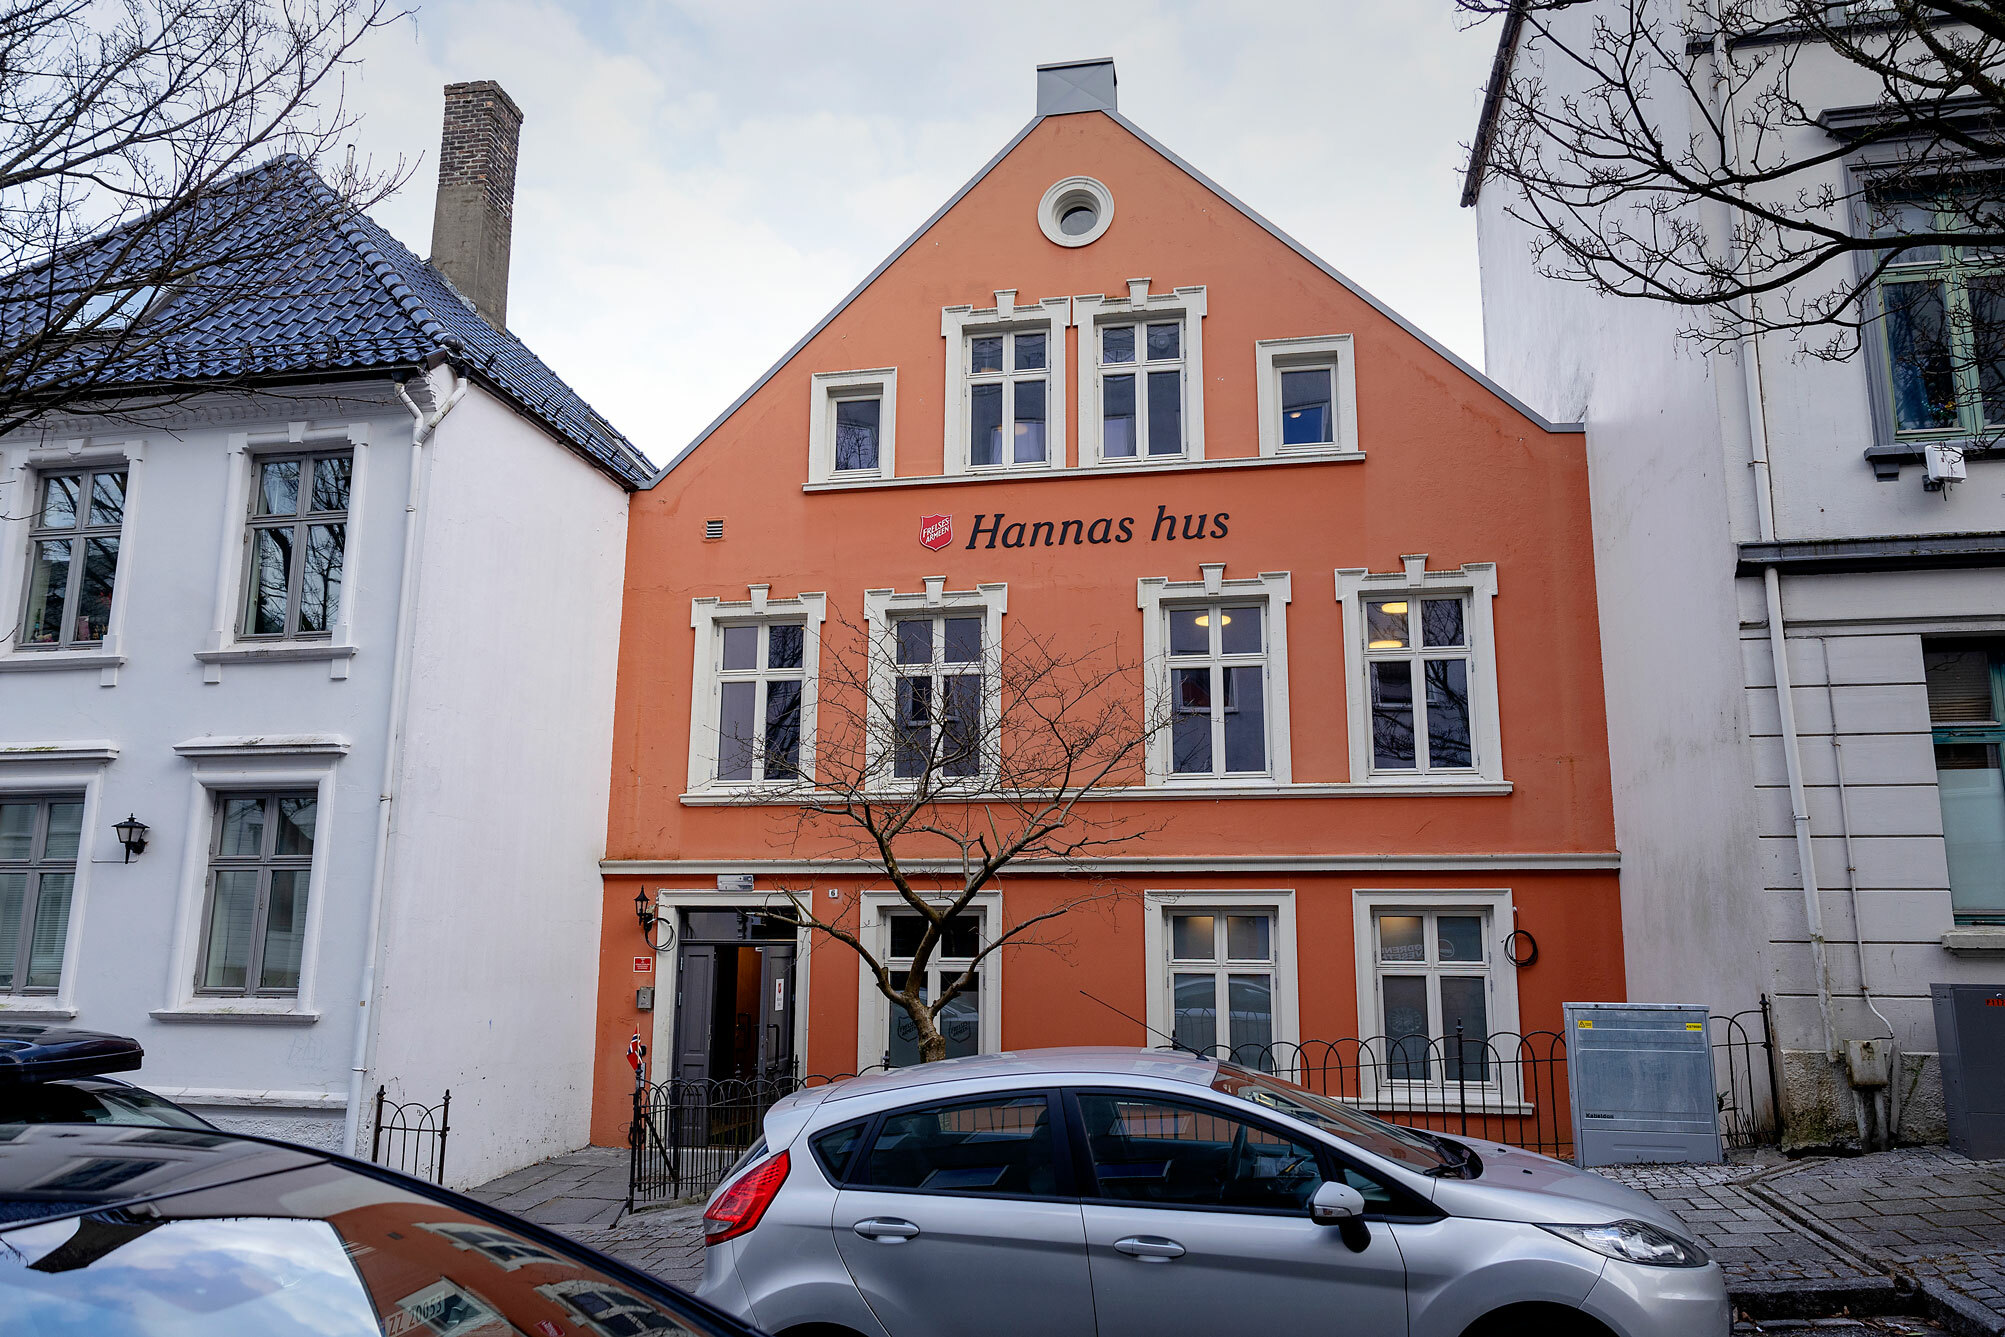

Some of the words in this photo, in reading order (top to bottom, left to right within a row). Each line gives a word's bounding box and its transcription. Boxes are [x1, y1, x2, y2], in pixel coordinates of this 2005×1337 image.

[923, 517, 950, 538] FRELSES
[925, 525, 950, 544] ARMEEN
[965, 513, 1135, 549] Hannas
[1151, 505, 1230, 541] hus
[389, 1313, 403, 1336] ZZ
